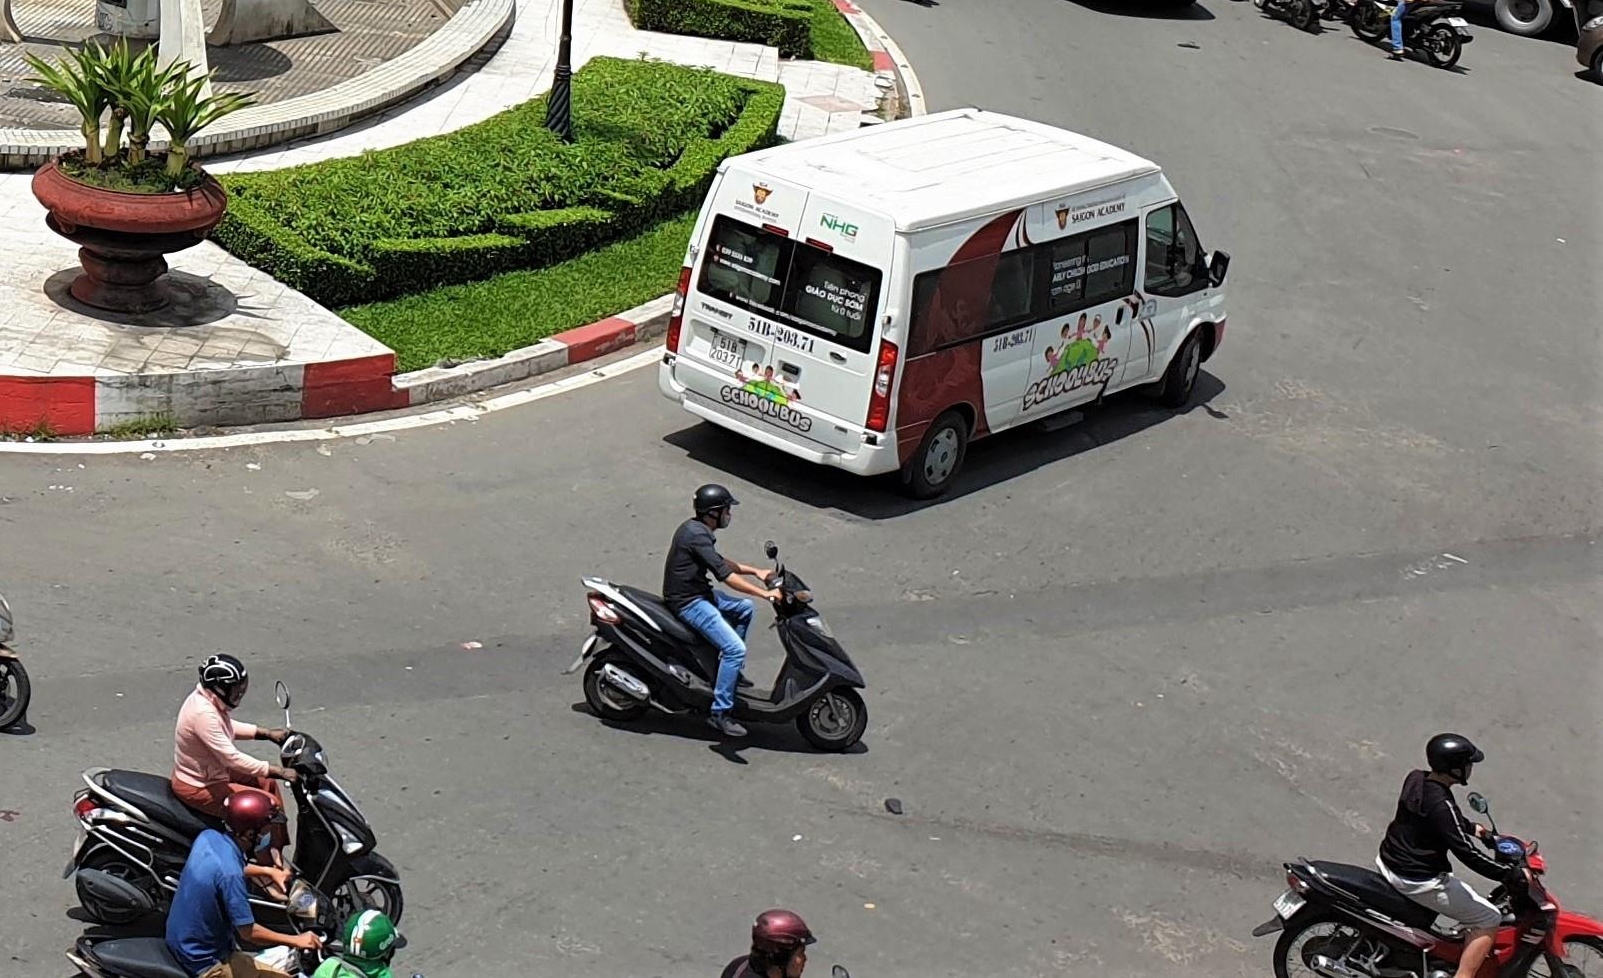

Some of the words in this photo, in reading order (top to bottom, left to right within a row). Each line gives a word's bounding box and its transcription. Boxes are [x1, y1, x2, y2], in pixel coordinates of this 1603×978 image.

[1071, 209, 1096, 224] SAIGON
[1097, 202, 1126, 218] ACADEMY
[819, 214, 859, 238] NHG
[719, 337, 739, 353] 51B
[747, 316, 816, 354] 51B-203.71
[1022, 371, 1084, 412] SCHOOL
[1082, 357, 1118, 386] BUS
[720, 384, 778, 418] SCHOOL
[777, 401, 812, 432] BUS
[378, 932, 395, 951] Grab
